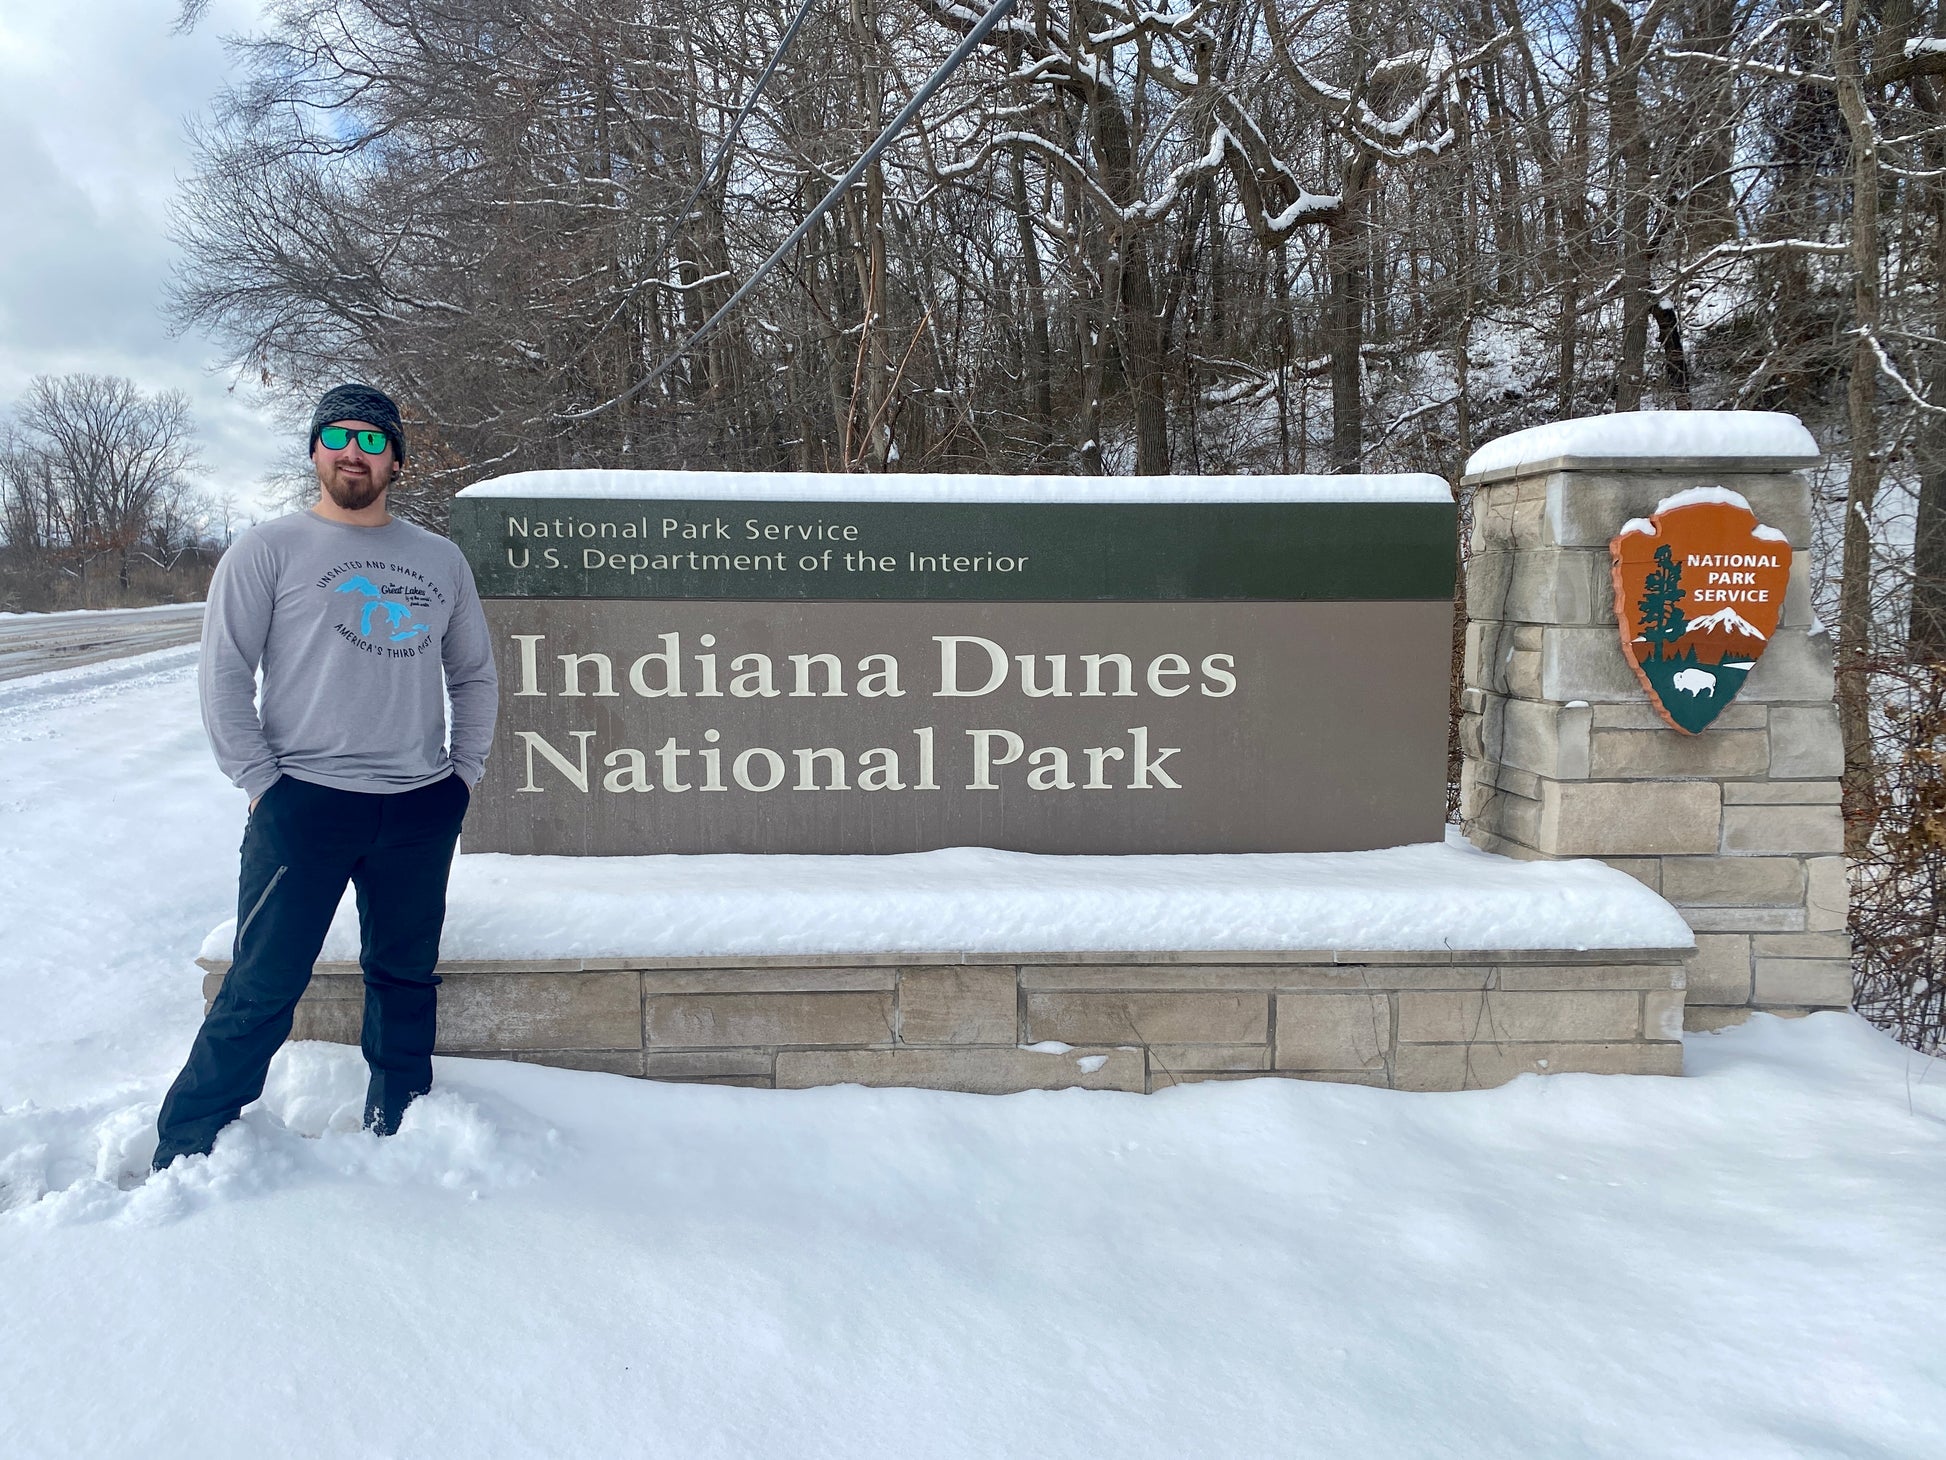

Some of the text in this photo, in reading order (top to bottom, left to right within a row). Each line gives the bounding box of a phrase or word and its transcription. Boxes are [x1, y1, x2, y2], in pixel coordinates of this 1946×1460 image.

[508, 516, 859, 541] National Park Service
[508, 548, 1029, 575] U.S. Department of the Interior
[1687, 554, 1781, 568] NATIONAL
[316, 560, 446, 605] UNSALTED AND SHARK FREE
[381, 585, 426, 596] Great Lakes
[1708, 572, 1756, 585] PARK
[1694, 589, 1769, 602] SERVICE
[333, 623, 432, 658] AMERICA'S THIRD CST
[510, 631, 1237, 698] Indiana Dunes
[514, 725, 1183, 793] National Park
